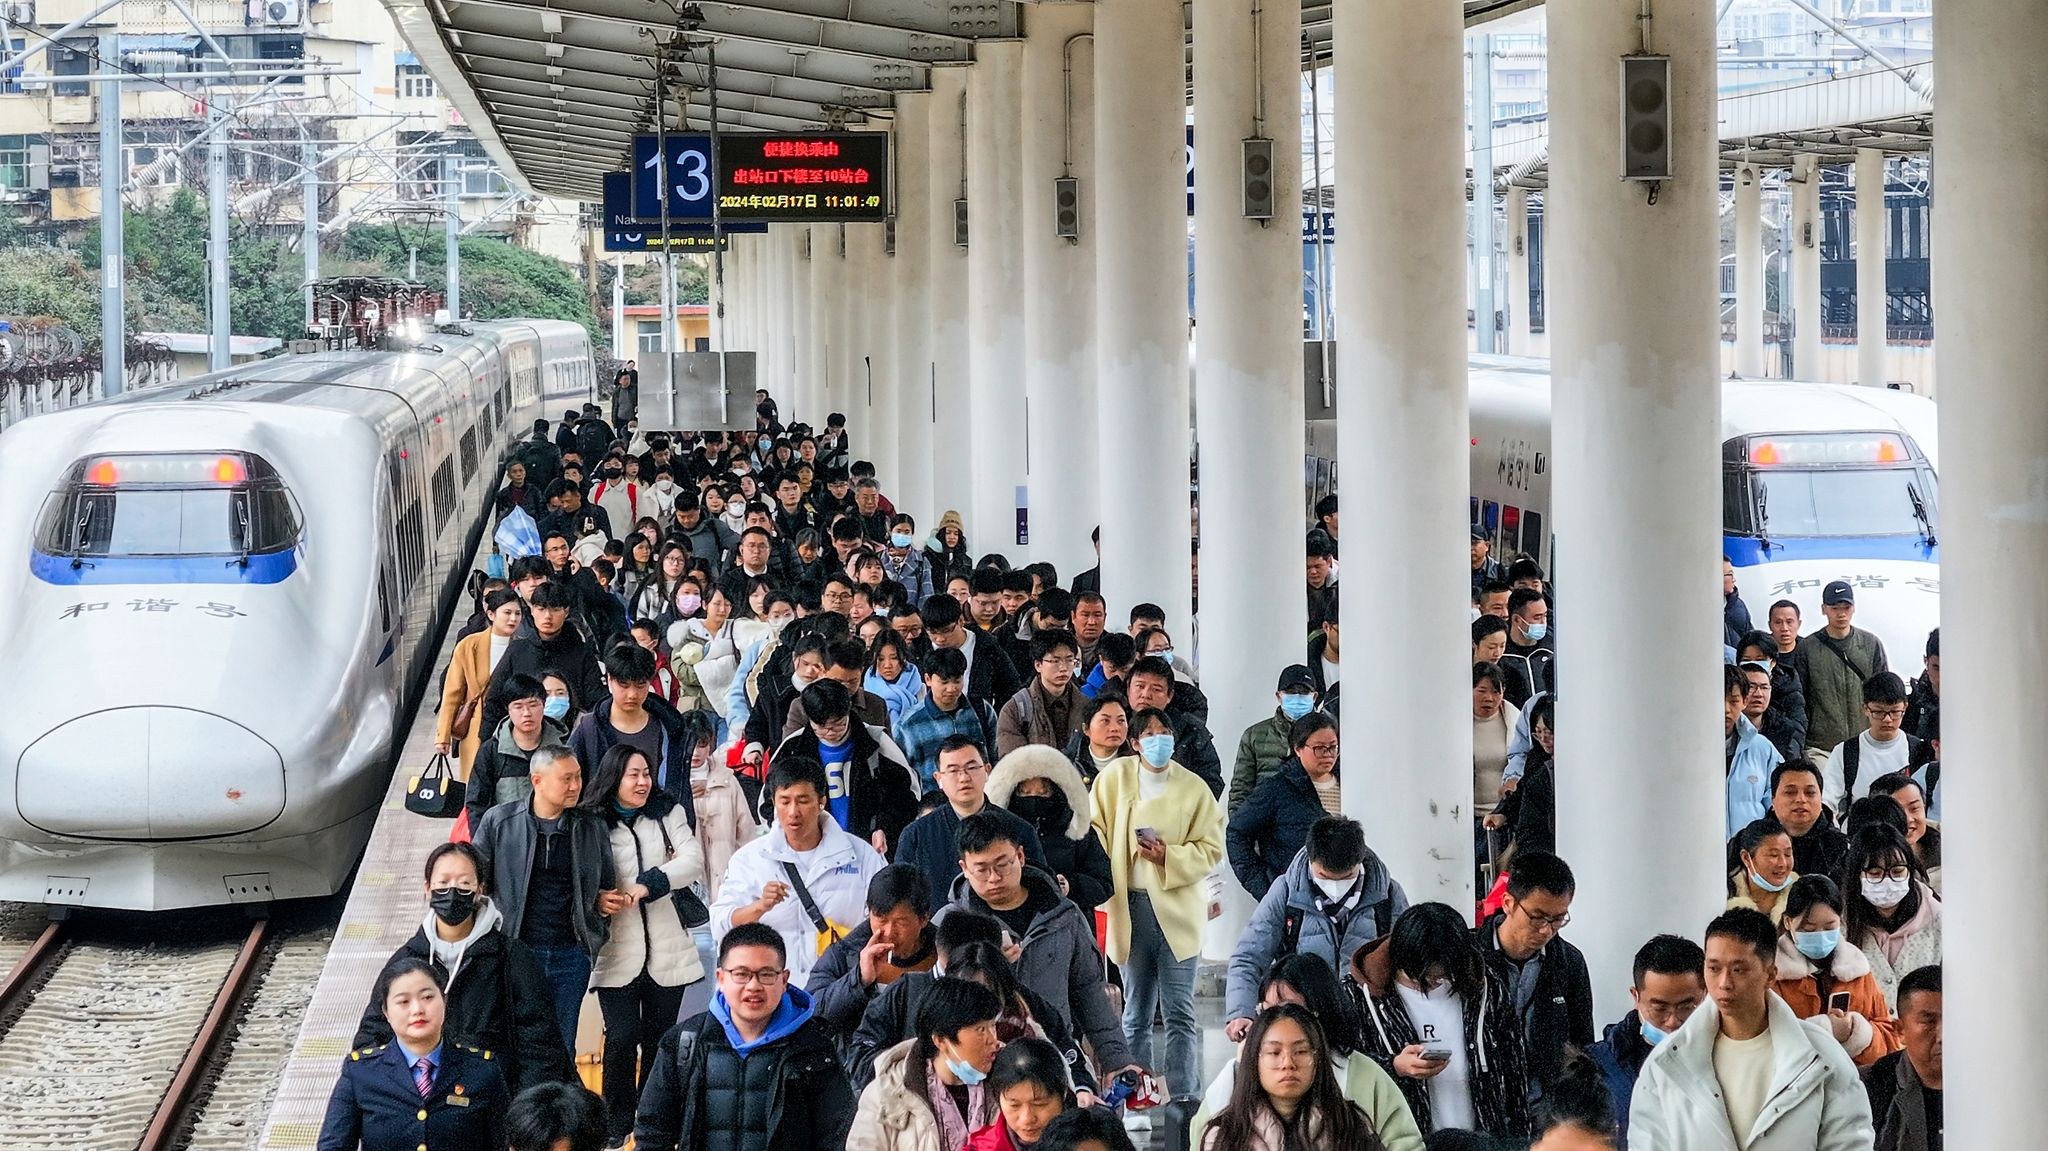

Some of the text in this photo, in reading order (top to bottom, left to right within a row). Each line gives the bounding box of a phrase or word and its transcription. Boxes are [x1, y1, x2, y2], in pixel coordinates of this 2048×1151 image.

[763, 141, 839, 157] 便捷换乘由
[644, 150, 709, 201] 13
[734, 168, 869, 184] 出站口下楼至10站台
[720, 195, 880, 208] 2024年02月17日 11:01:49
[58, 598, 248, 620] 和谐号
